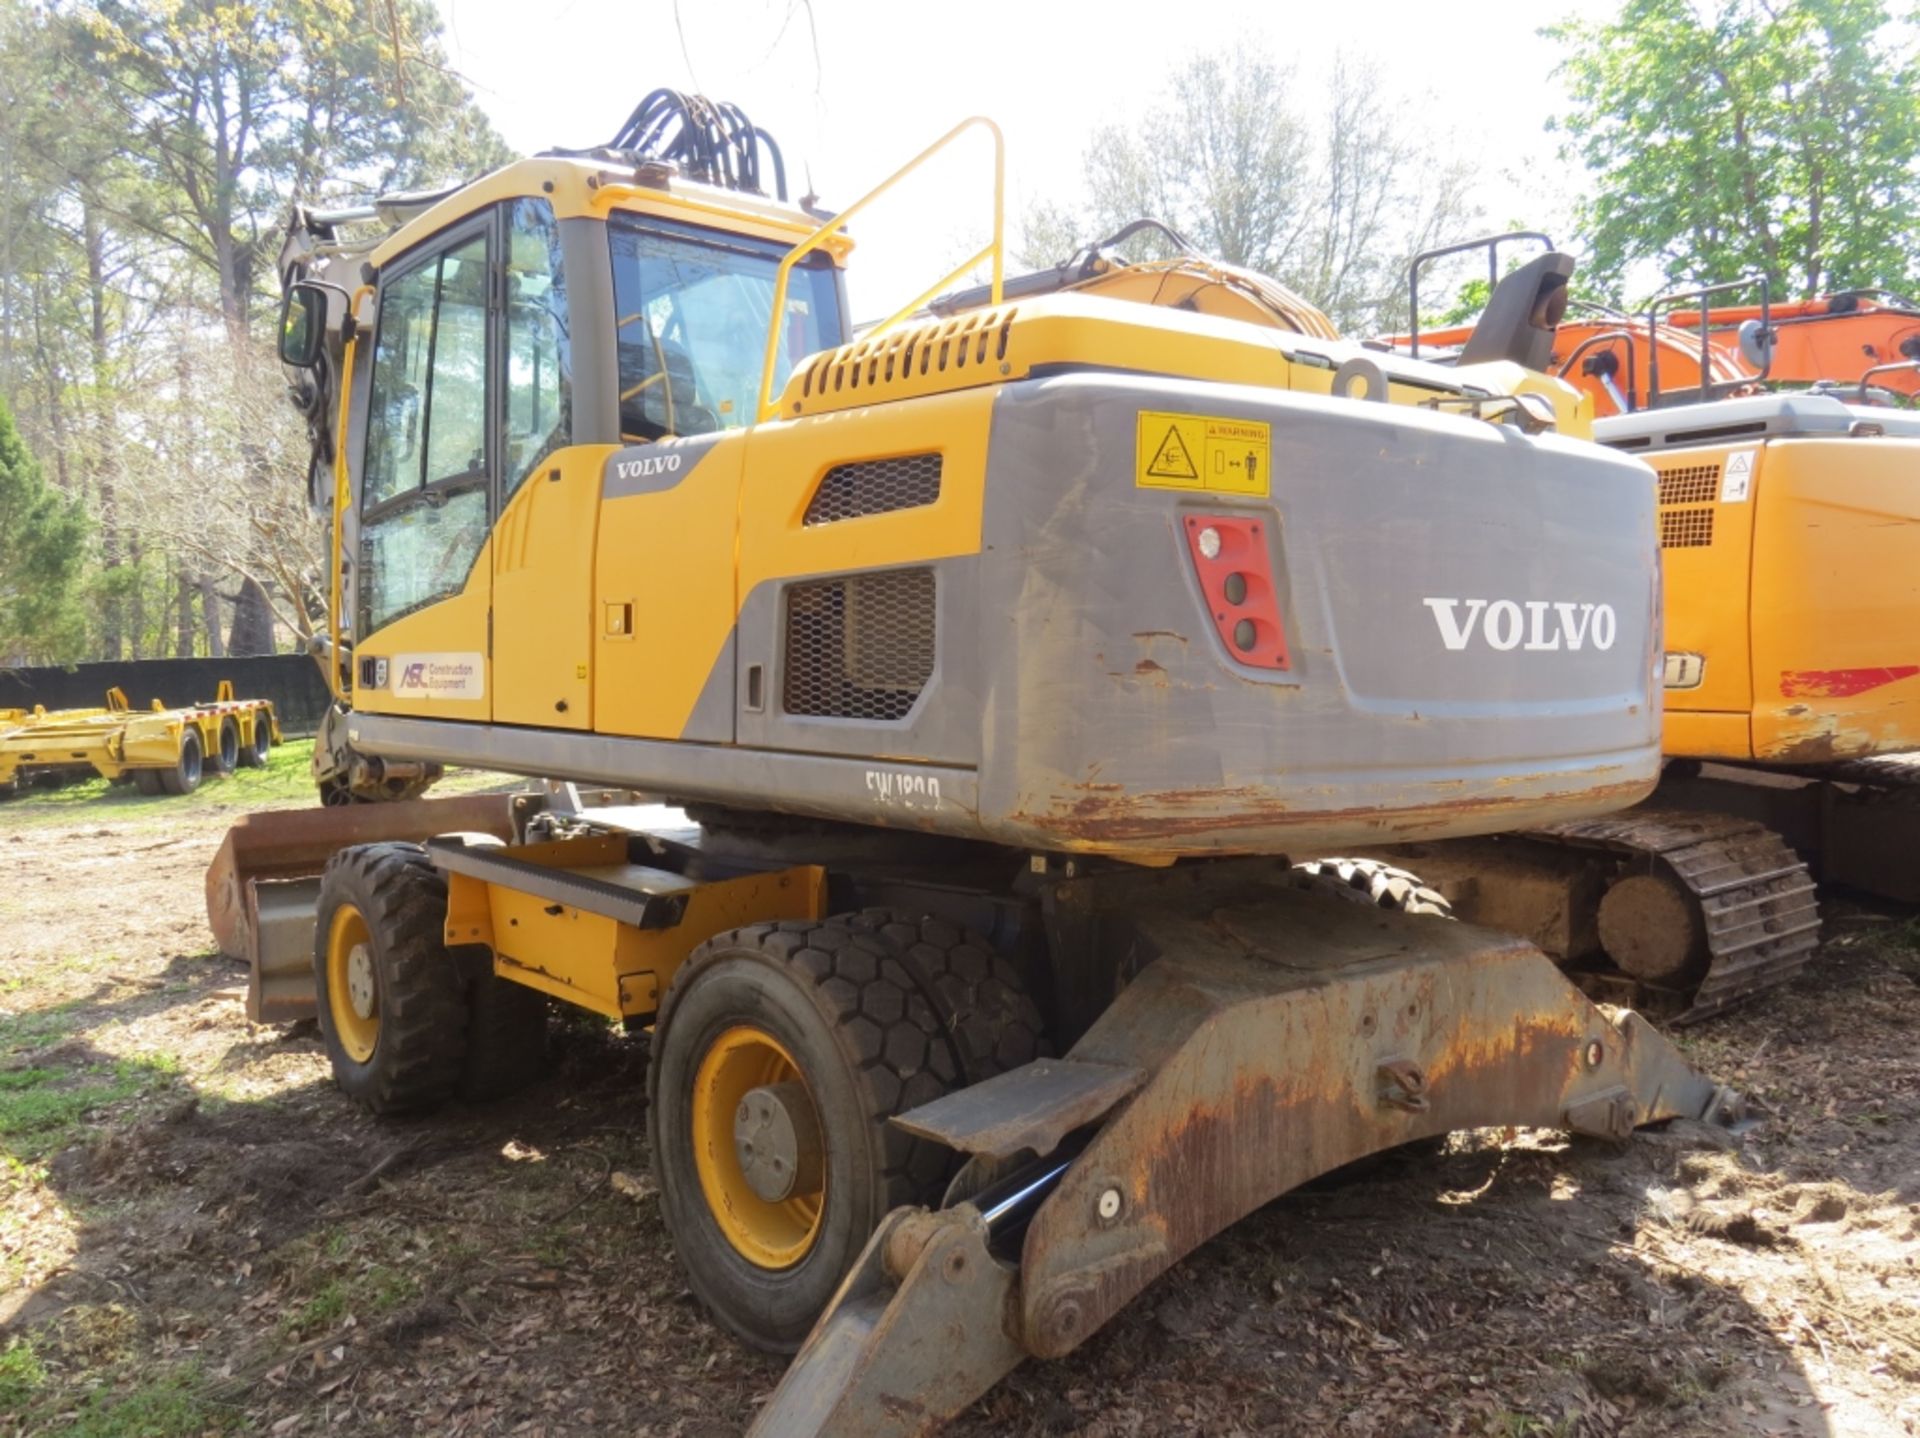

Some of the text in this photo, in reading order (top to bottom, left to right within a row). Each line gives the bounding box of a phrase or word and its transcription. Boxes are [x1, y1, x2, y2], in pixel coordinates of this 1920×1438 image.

[1218, 426, 1265, 440] WARNING
[616, 453, 682, 479] VOLVO
[1423, 597, 1616, 651] VOLVO
[428, 663, 473, 676] Construction
[428, 676, 466, 690] Equipment
